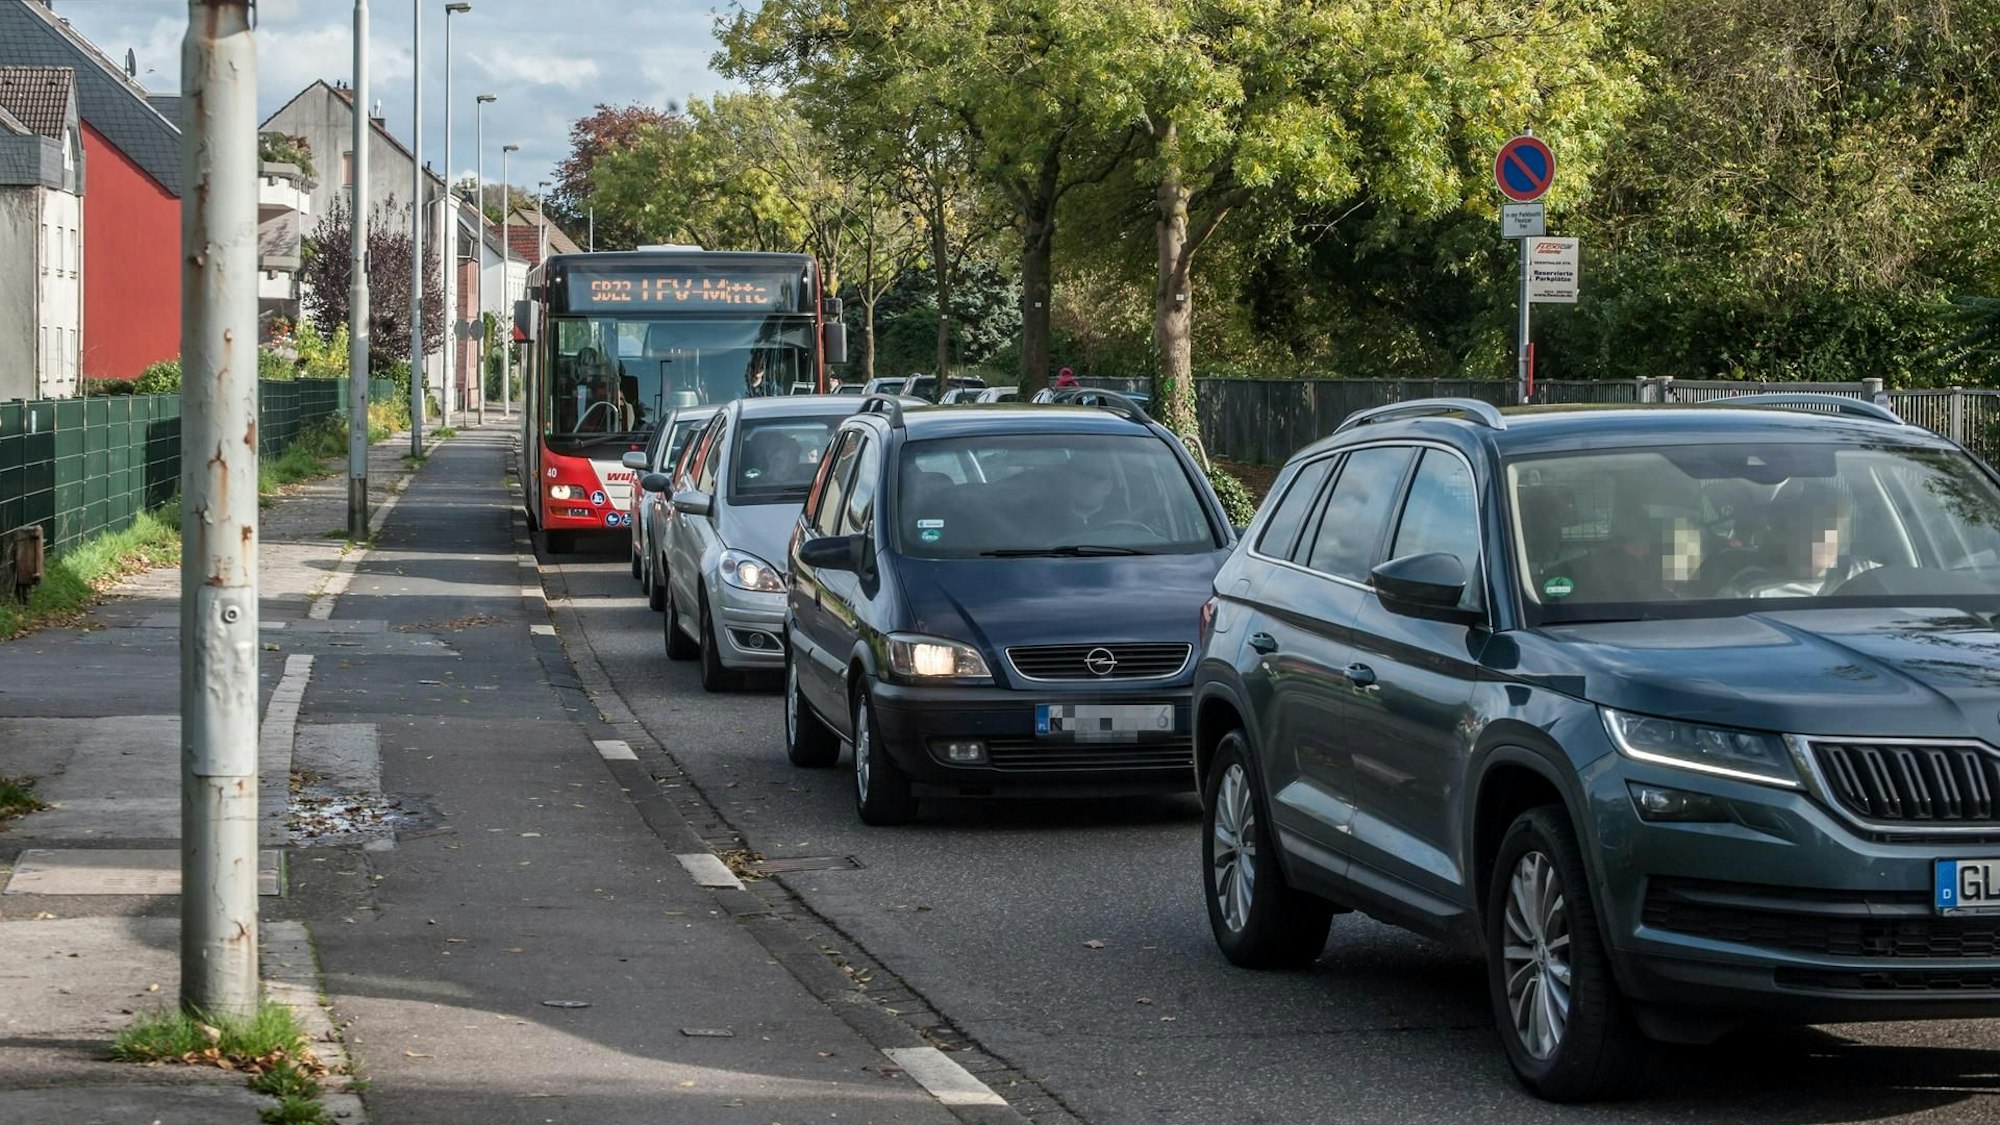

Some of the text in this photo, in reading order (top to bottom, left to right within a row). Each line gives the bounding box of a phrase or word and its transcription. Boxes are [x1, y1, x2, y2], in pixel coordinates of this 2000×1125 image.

[546, 467, 558, 478] 40
[1942, 865, 2000, 901] D GL
